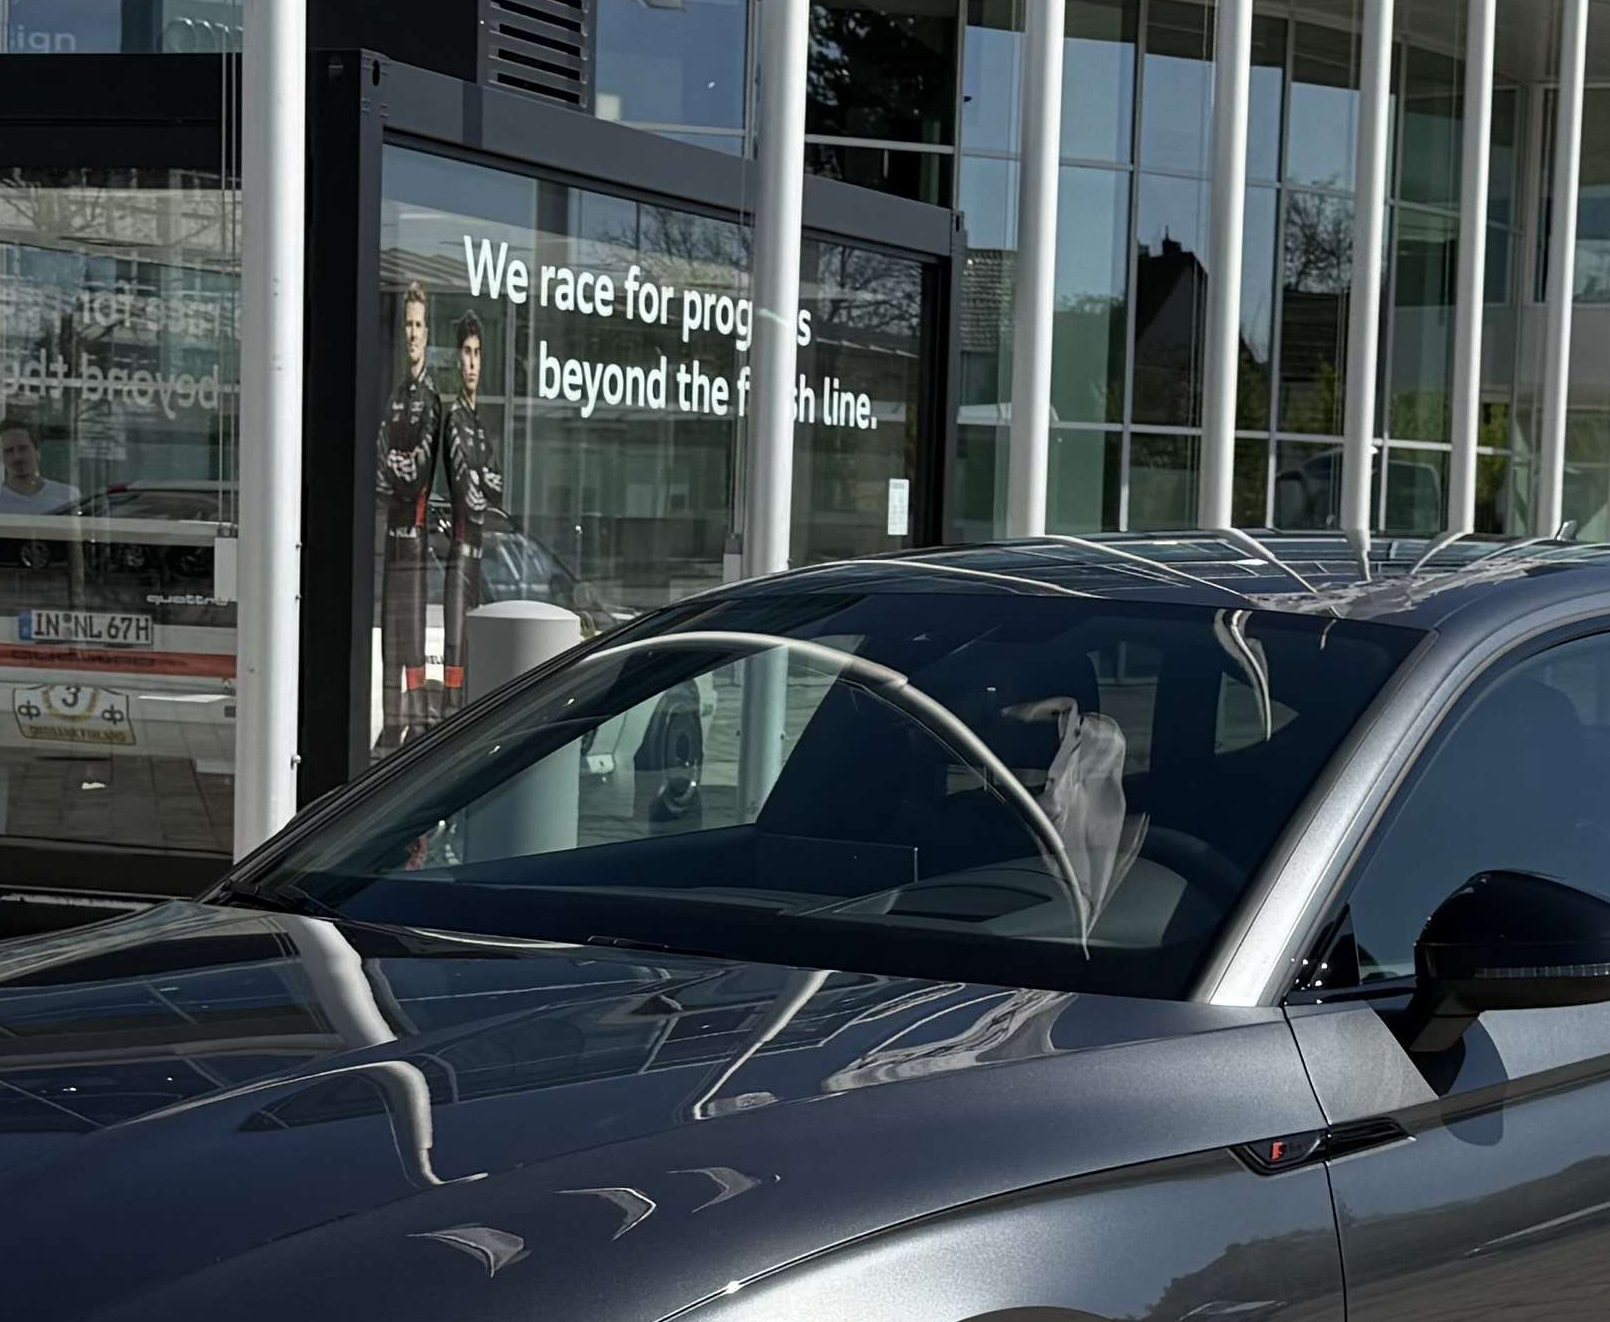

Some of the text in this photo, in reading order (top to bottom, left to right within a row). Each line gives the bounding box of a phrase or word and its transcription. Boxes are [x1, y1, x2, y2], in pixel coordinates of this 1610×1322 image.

[463, 235, 812, 352] We race for progs
[539, 341, 667, 418] beyond
[677, 359, 729, 416] the
[823, 376, 878, 430] line.
[34, 613, 151, 642] IN NL 67H
[61, 685, 80, 708] 3
